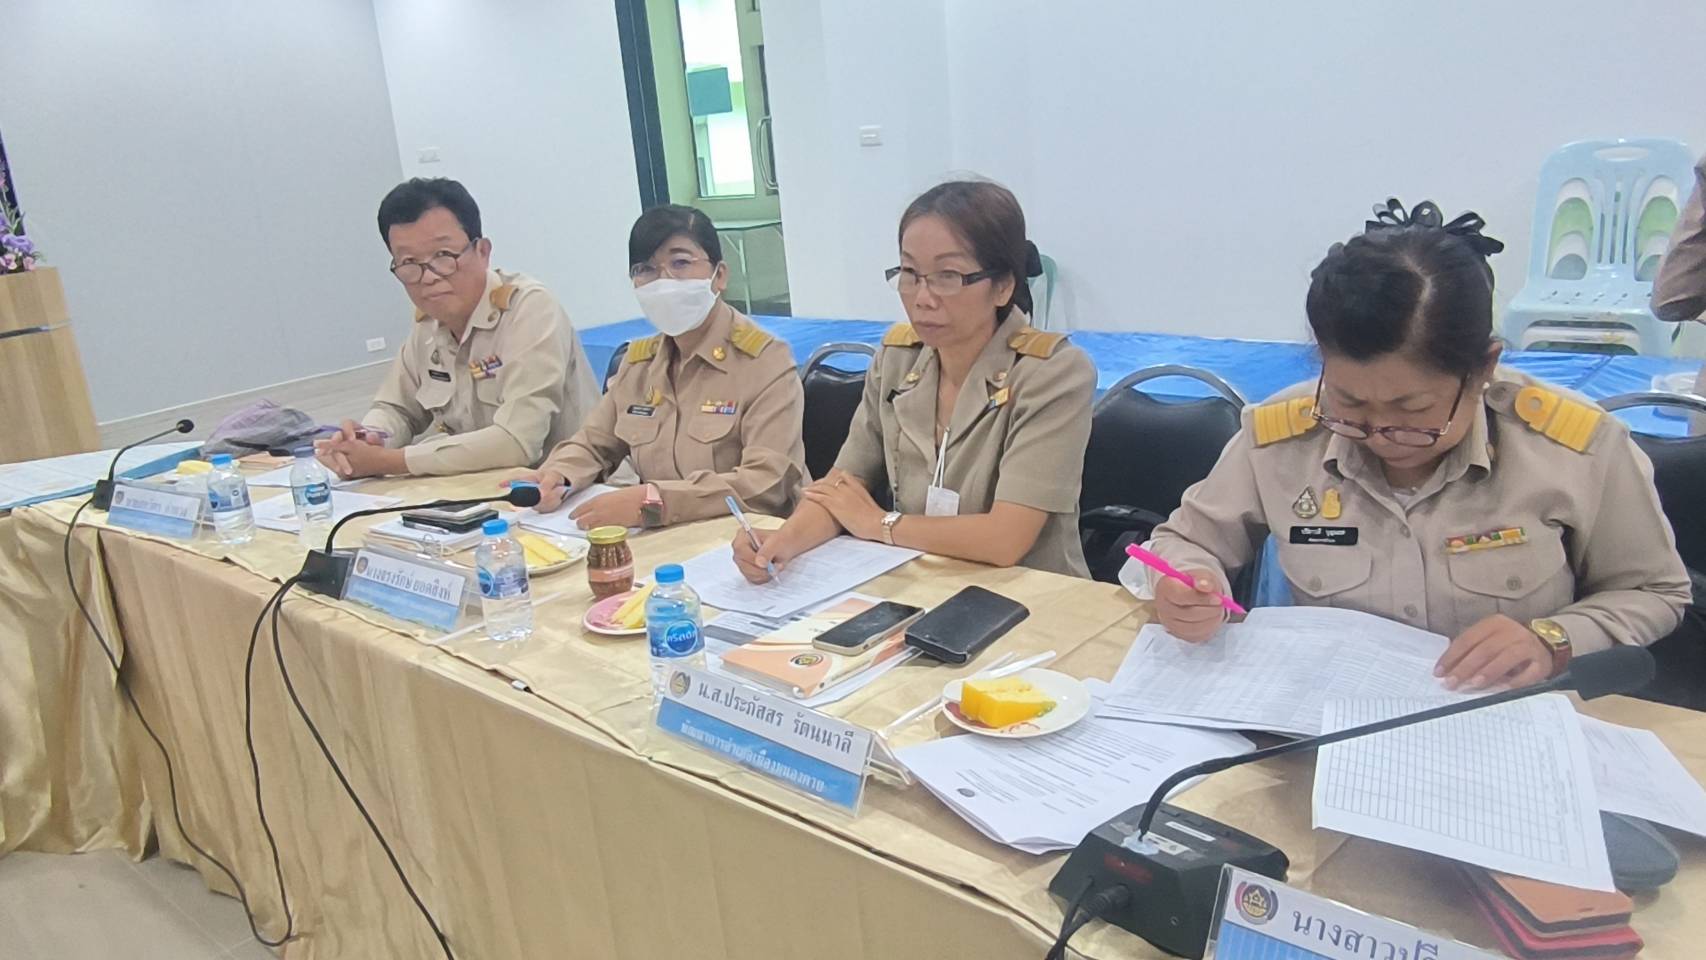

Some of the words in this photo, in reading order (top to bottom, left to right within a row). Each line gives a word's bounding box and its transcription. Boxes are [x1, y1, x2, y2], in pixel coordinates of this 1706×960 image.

[698, 681, 784, 727] น.ส.ประภัสสร
[793, 711, 854, 754] รัตนนาลี
